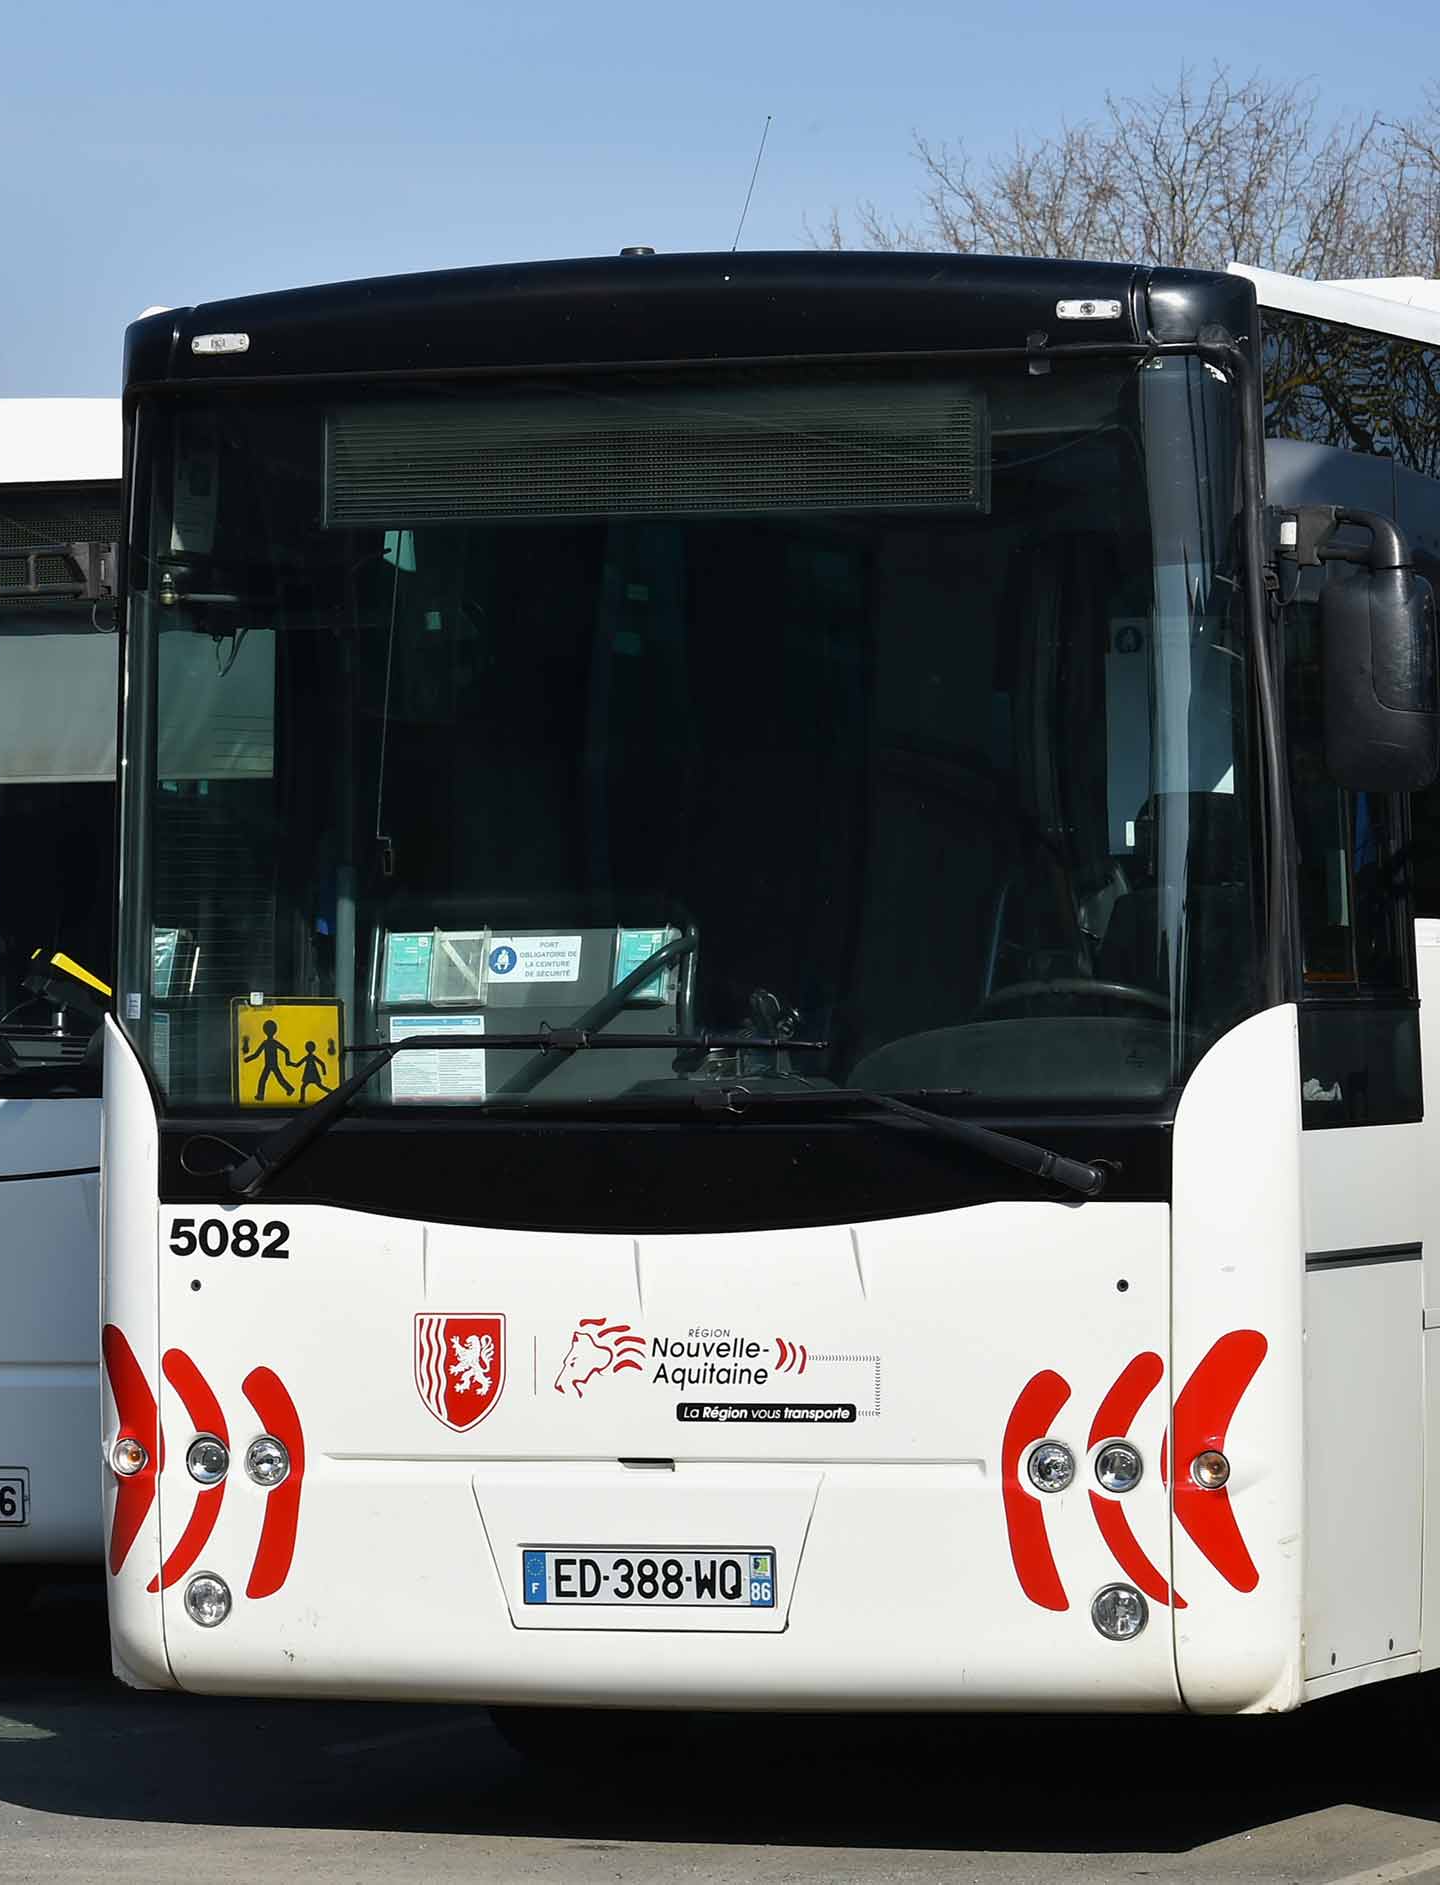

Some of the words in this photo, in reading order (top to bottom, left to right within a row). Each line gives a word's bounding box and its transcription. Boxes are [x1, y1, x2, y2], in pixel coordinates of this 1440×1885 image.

[169, 1218, 290, 1259] 5082
[688, 1326, 731, 1338] RÉGION
[651, 1337, 770, 1358] Nouvelle-
[652, 1363, 769, 1391] Aquitaine
[683, 1407, 700, 1419] La
[702, 1406, 748, 1423] Région
[751, 1410, 781, 1419] vous
[783, 1408, 850, 1424] transporte
[531, 1582, 540, 1594] F
[751, 1582, 771, 1601] 86
